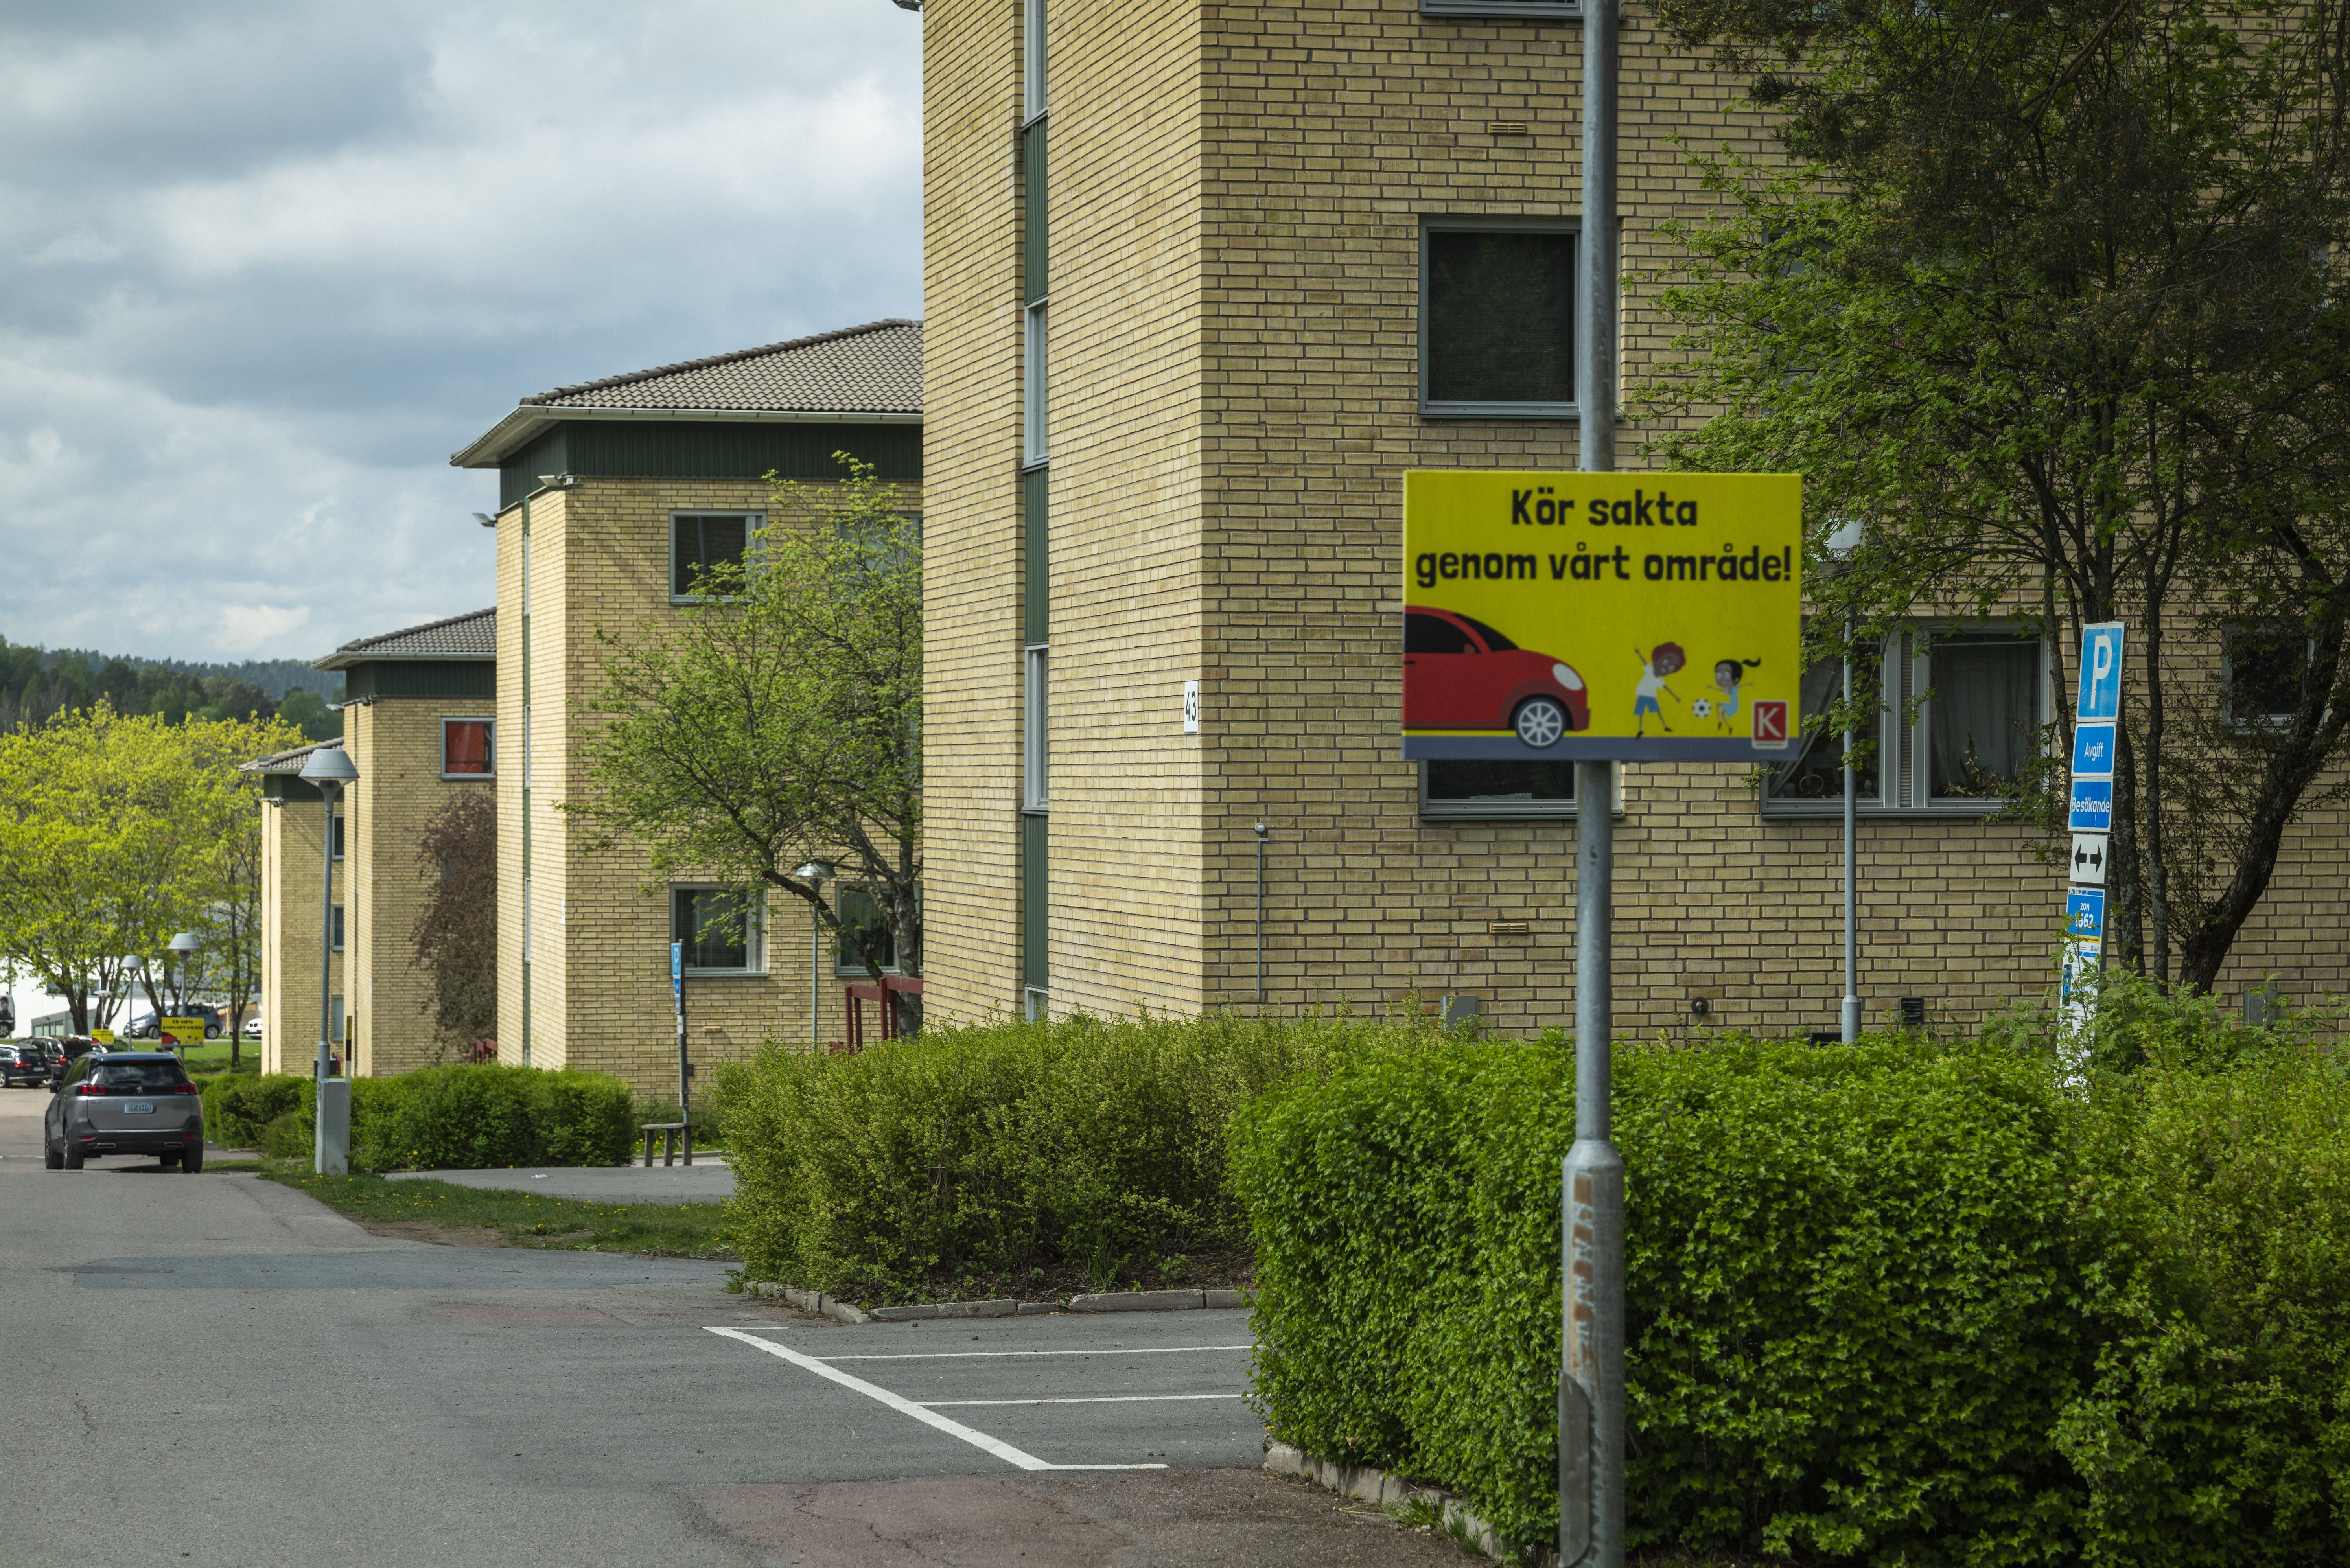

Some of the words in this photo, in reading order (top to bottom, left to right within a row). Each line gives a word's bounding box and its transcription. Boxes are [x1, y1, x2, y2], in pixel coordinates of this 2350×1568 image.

[1512, 487, 1574, 526] Kör
[1588, 489, 1698, 526] sakta
[1416, 551, 1537, 589] genom
[1548, 542, 1630, 580] vårt
[1644, 543, 1791, 582] område!
[2090, 635, 2112, 709] P
[1186, 691, 1196, 722] 43
[1758, 707, 1782, 737] K
[2084, 742, 2103, 762] Avgift
[2071, 797, 2110, 813] Besökande
[2080, 902, 2090, 911] ZON
[674, 947, 679, 973] P
